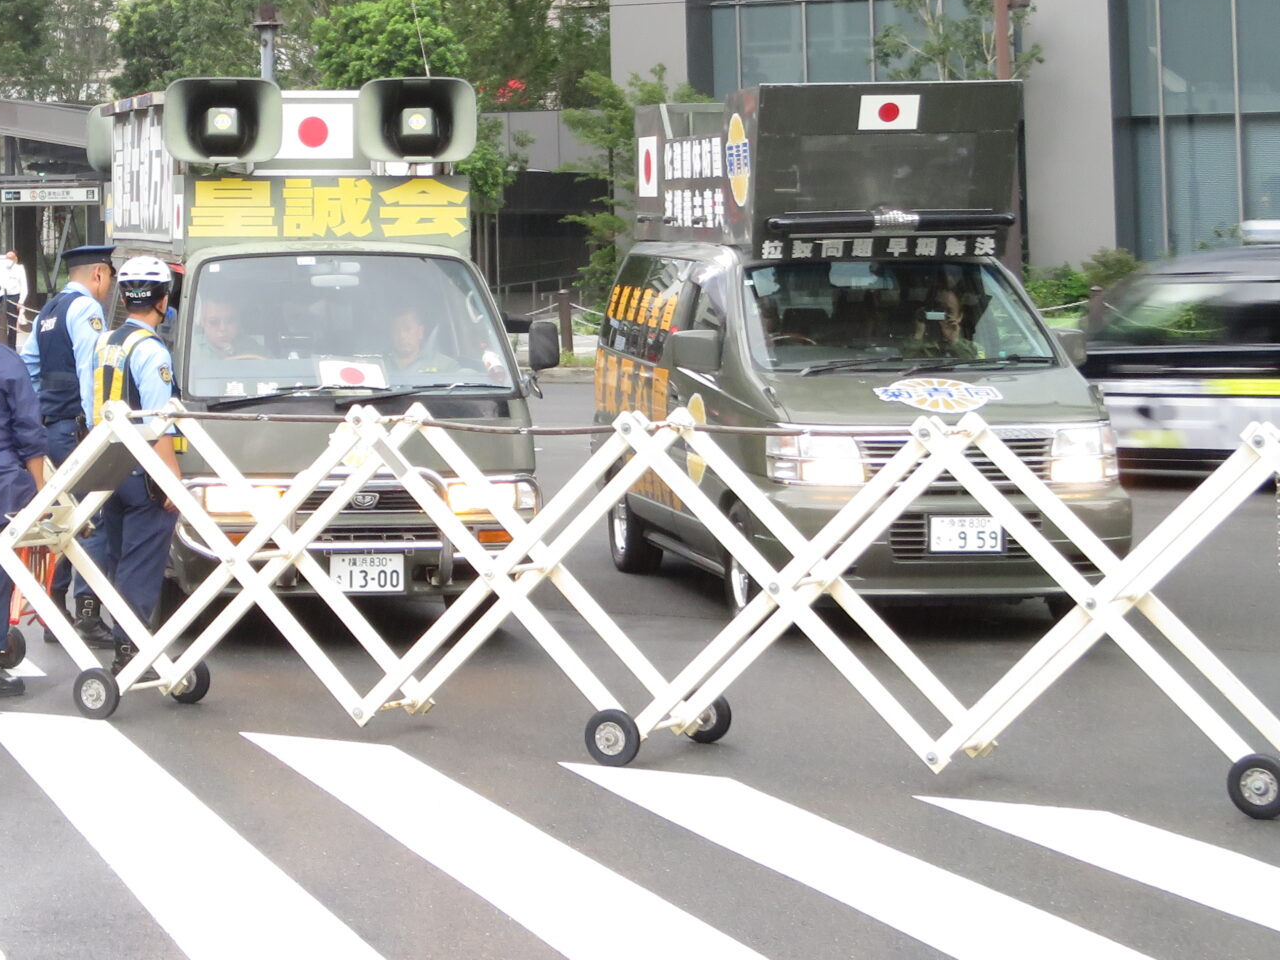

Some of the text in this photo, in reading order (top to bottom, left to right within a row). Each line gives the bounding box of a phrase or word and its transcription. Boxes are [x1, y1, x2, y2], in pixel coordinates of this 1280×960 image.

[188, 178, 469, 238] 皇誠会
[125, 290, 152, 299] POLICE
[349, 569, 400, 588] 13-00
